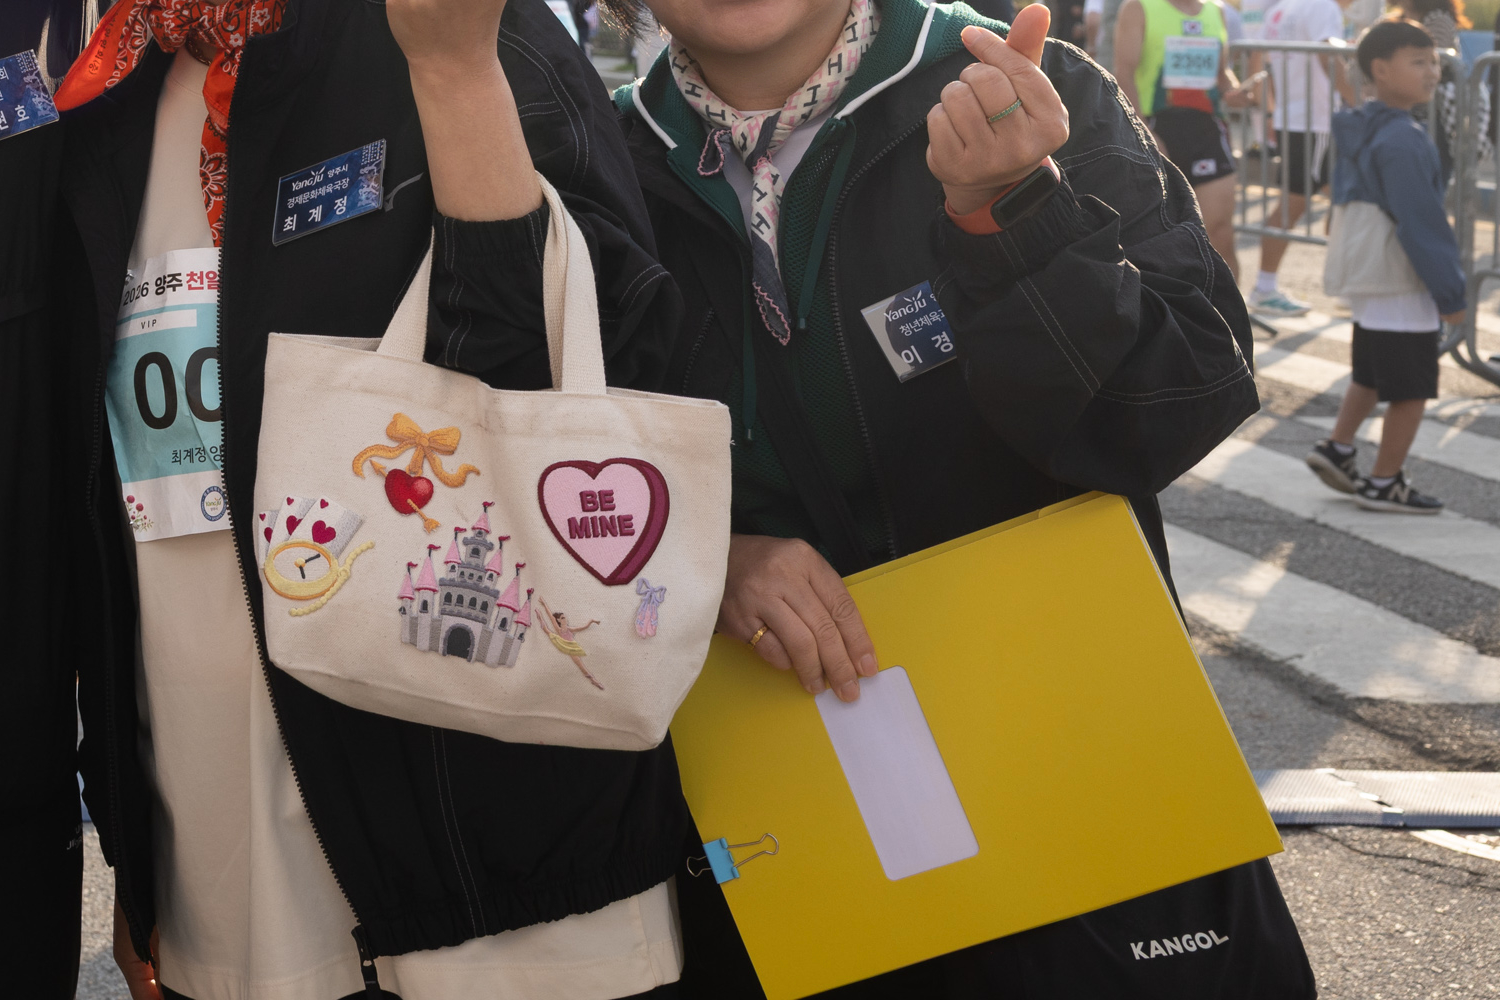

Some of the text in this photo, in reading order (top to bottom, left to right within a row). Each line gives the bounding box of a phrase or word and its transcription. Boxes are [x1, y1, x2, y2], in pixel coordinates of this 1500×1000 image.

[123, 281, 149, 307] 2026
[154, 273, 183, 296] 양주
[140, 319, 157, 330] VIP
[171, 446, 207, 466] 최계정
[579, 489, 616, 512] BE
[567, 514, 636, 540] MINE
[1130, 929, 1230, 960] KANGOL
